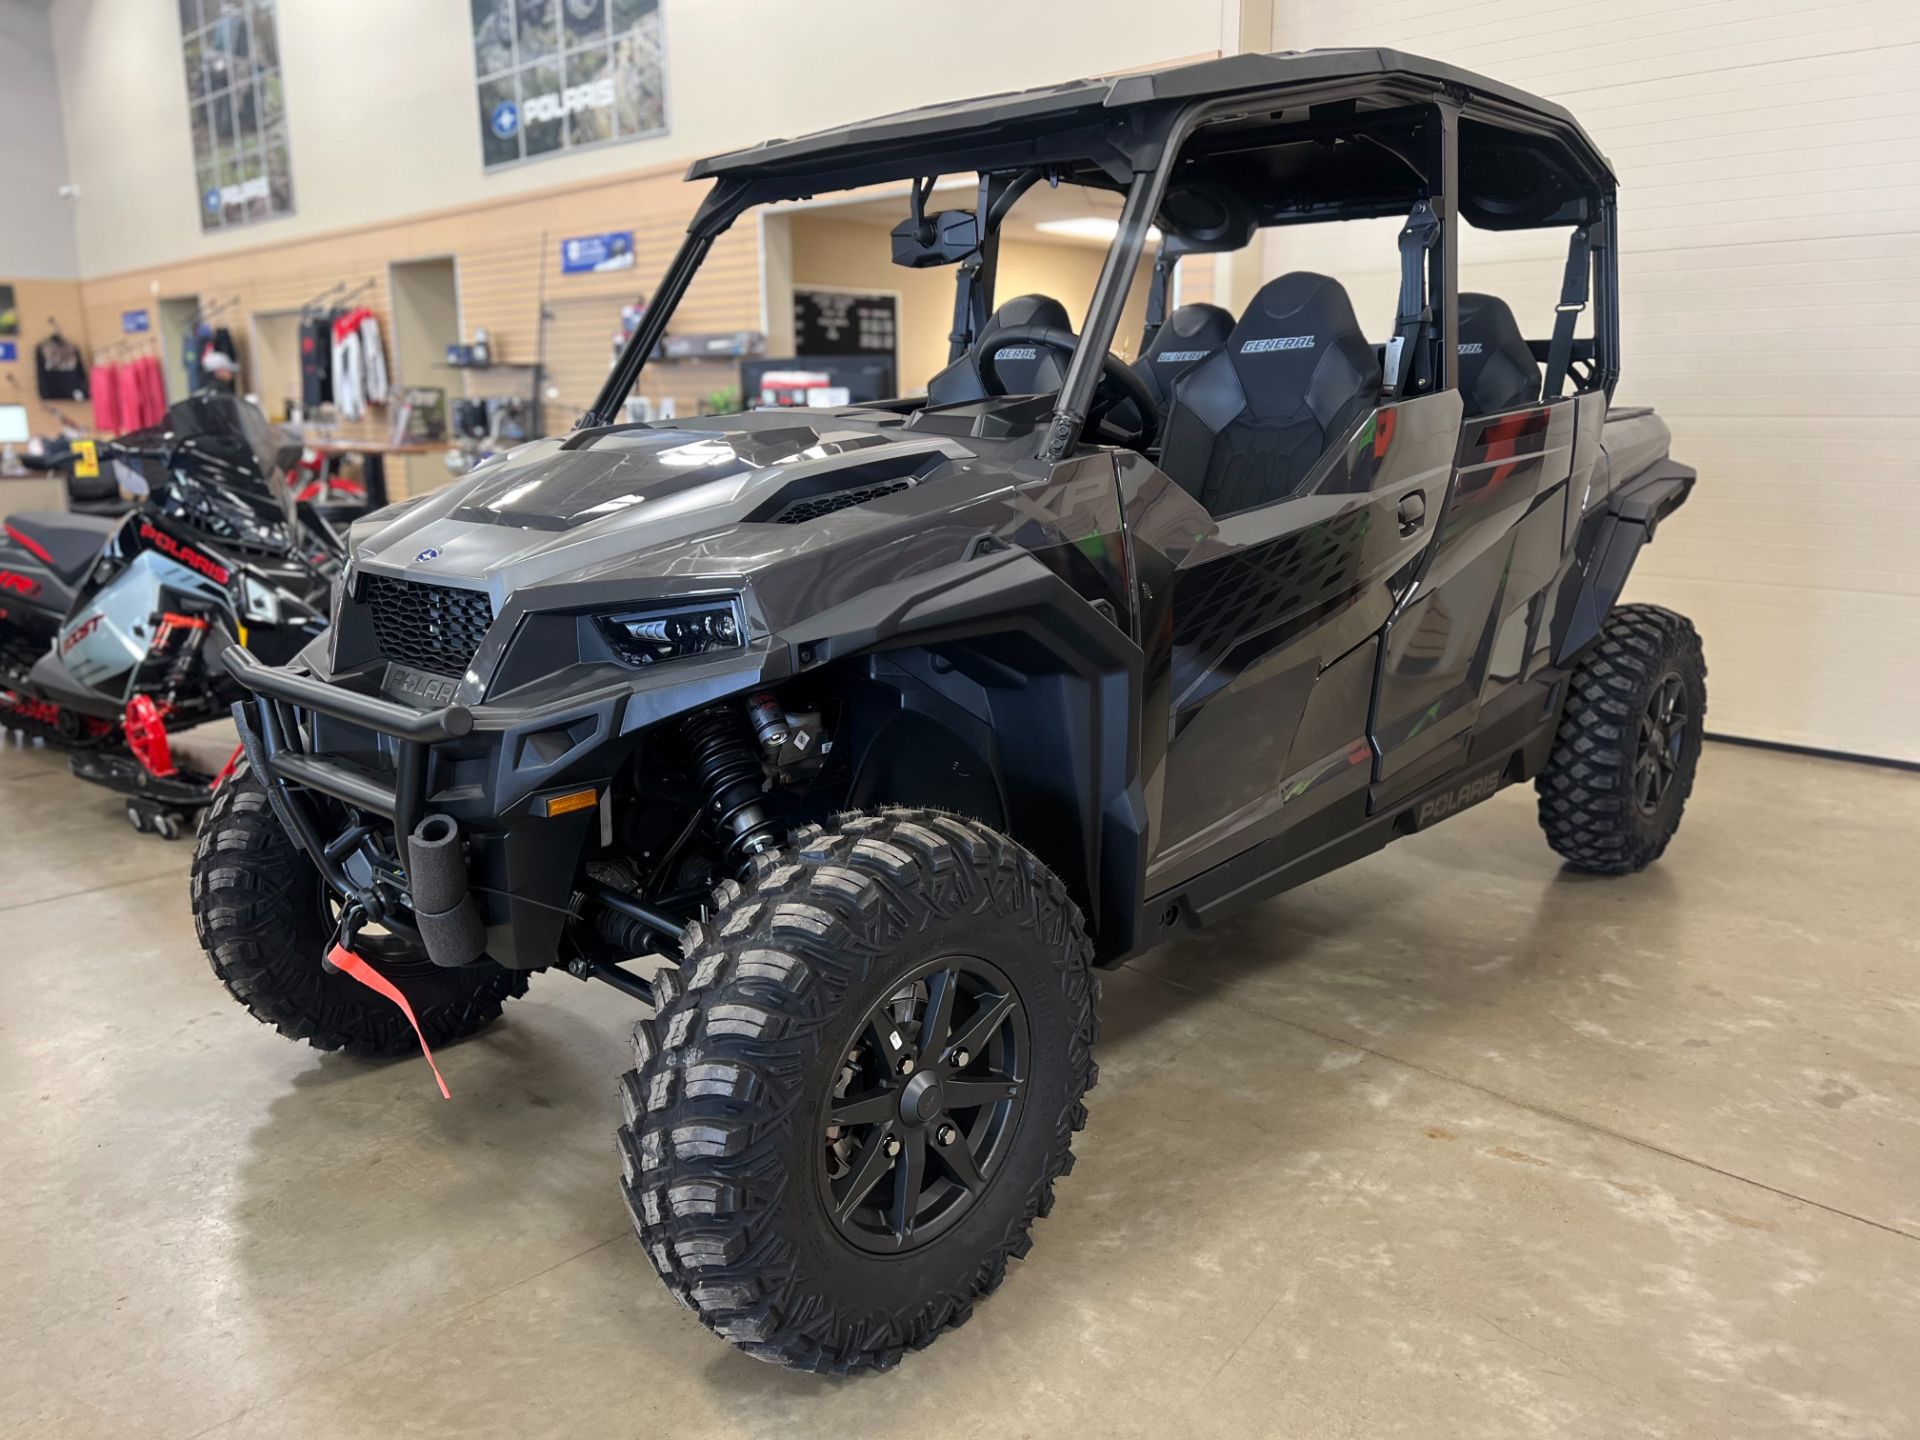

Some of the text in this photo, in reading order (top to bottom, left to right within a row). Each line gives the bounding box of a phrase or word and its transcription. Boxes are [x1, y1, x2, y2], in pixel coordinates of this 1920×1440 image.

[523, 78, 615, 126] POLARIS
[994, 348, 1036, 360] NERAL
[1240, 335, 1314, 353] GENERAL
[995, 473, 1110, 538] XP
[140, 523, 229, 585] POLARIS
[388, 669, 457, 704] POLAR
[1419, 770, 1500, 825] POLARIS
